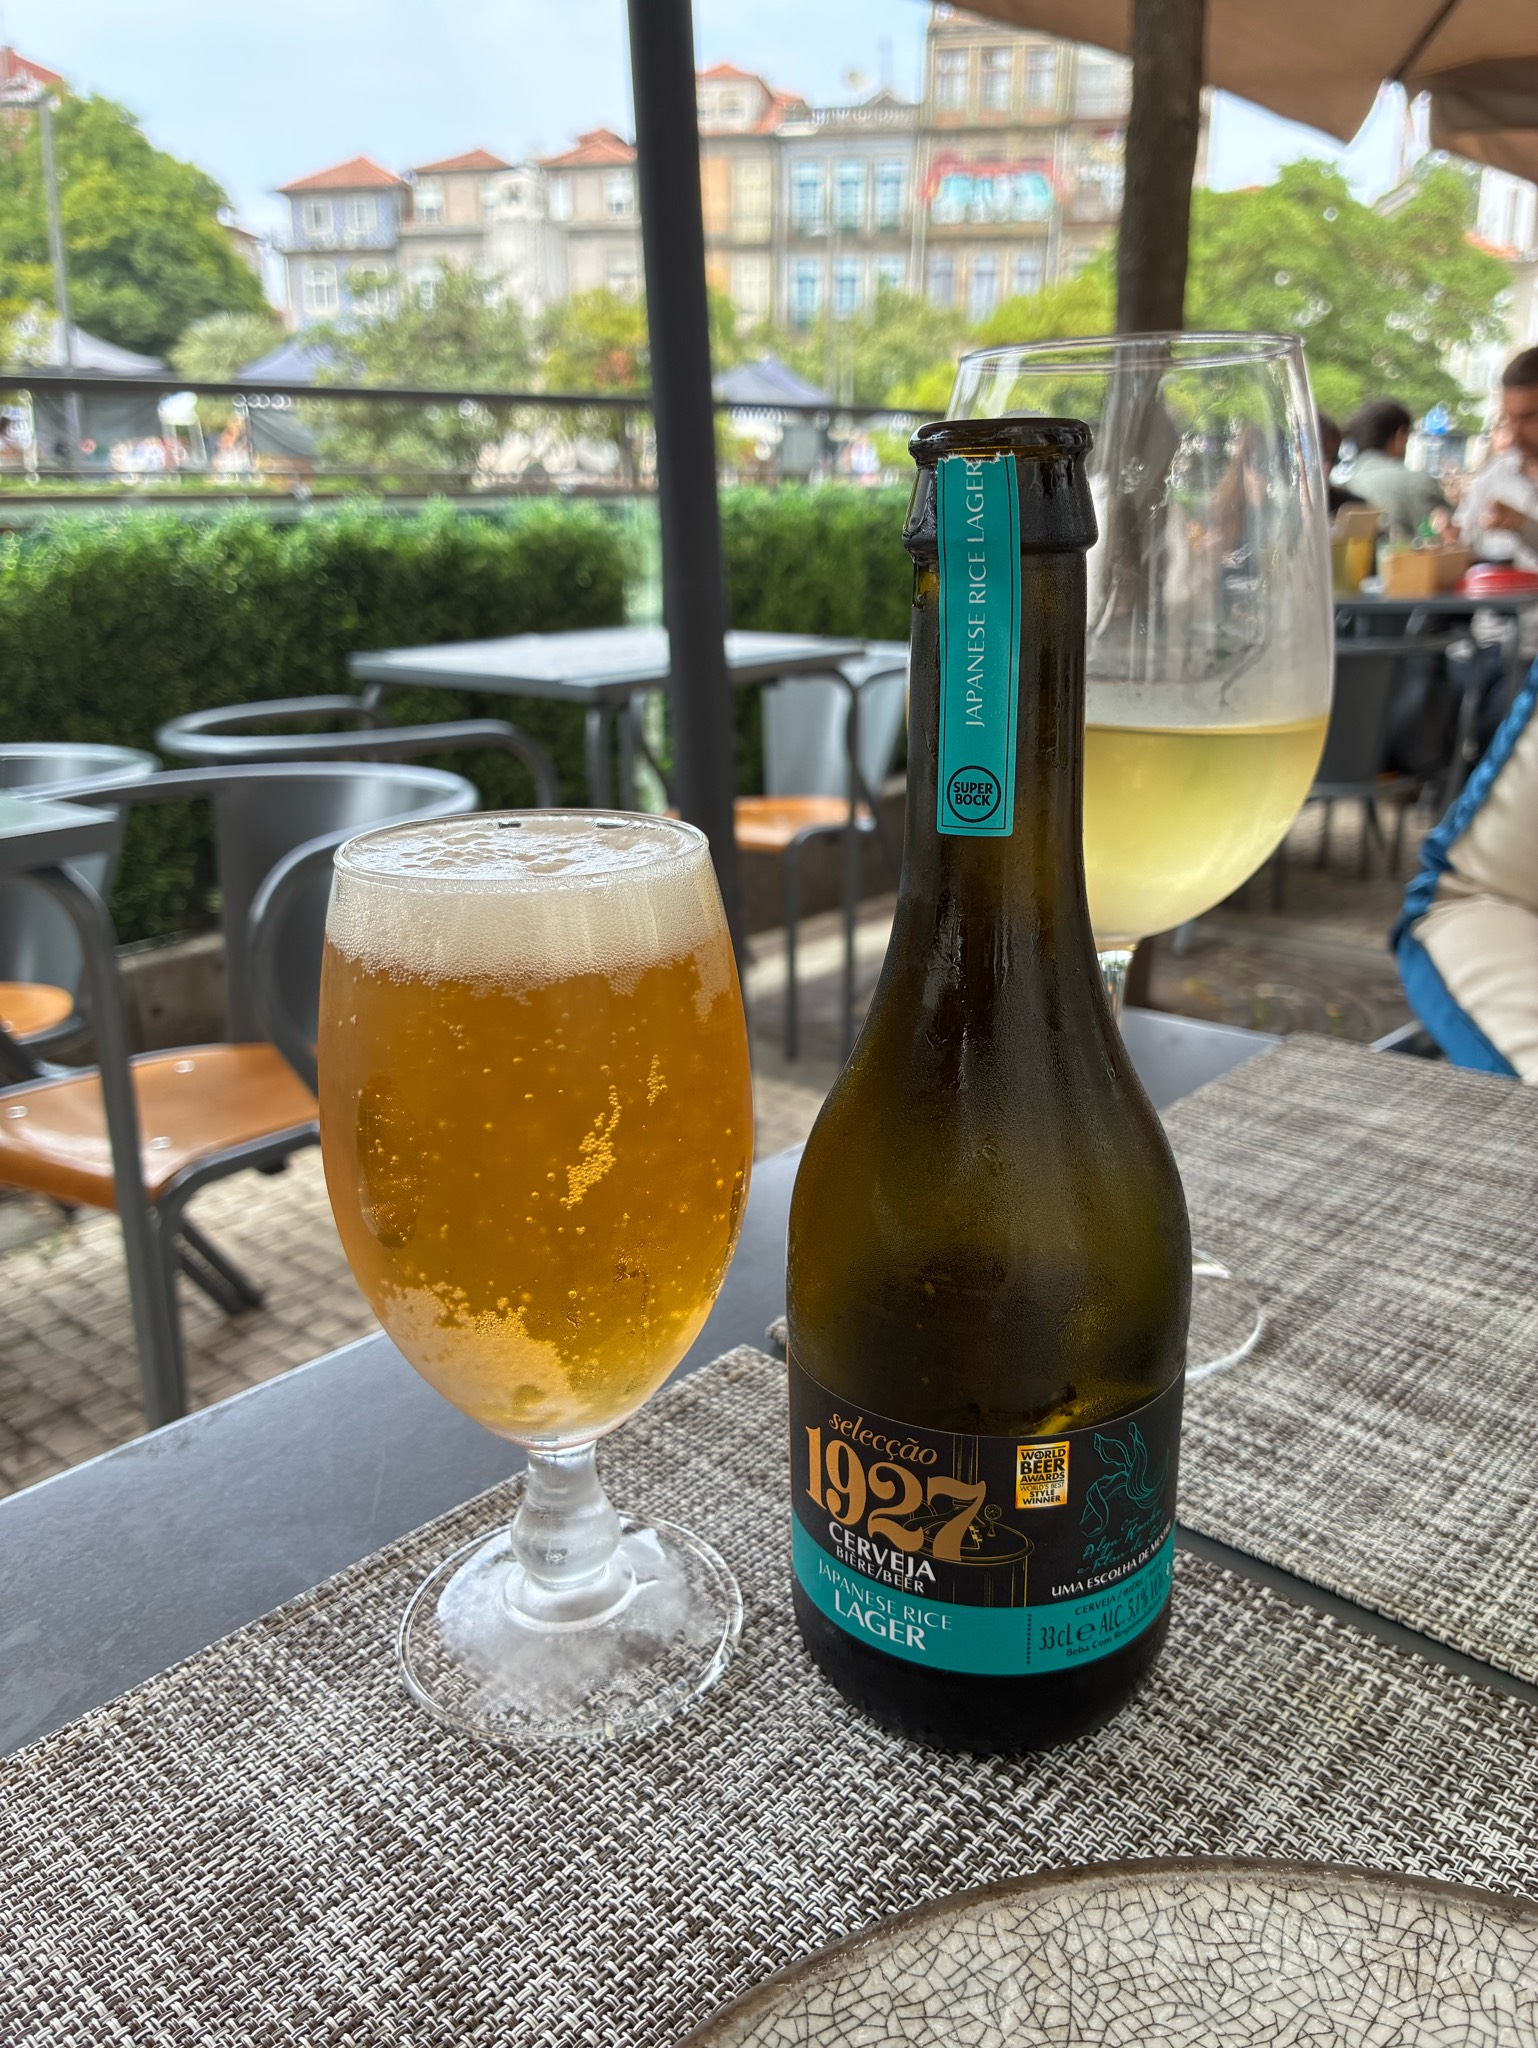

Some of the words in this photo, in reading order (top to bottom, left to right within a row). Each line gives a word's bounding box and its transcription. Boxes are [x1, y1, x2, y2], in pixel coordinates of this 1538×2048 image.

[965, 459, 985, 542] LAGER
[968, 551, 987, 604] RICE
[966, 612, 986, 728] JAPANESE
[952, 781, 994, 796] SUPER
[954, 792, 992, 807] BOCK
[828, 1413, 938, 1465] selecção
[1021, 1448, 1066, 1461] WORLD
[1020, 1457, 1065, 1475] BEER
[1020, 1471, 1065, 1483] AWARDS
[805, 1425, 987, 1562] 1927
[1020, 1483, 1050, 1492] WORLD'S
[1050, 1481, 1065, 1490] BEST
[1022, 1495, 1061, 1505] WINNER
[1029, 1488, 1055, 1498] STYLE
[828, 1521, 937, 1582] CERVEJA
[835, 1545, 925, 1594] BIÈRE/BEER
[1051, 1581, 1084, 1598] UMA
[1086, 1558, 1138, 1589] ESCOLHA
[1138, 1548, 1150, 1564] DE
[818, 1559, 897, 1616] JAPANESE
[902, 1605, 953, 1631] RICE
[834, 1589, 927, 1651] LAGER
[1099, 1604, 1125, 1635] ALC.
[1066, 1644, 1090, 1657] Beba
[1091, 1636, 1112, 1650] Com
